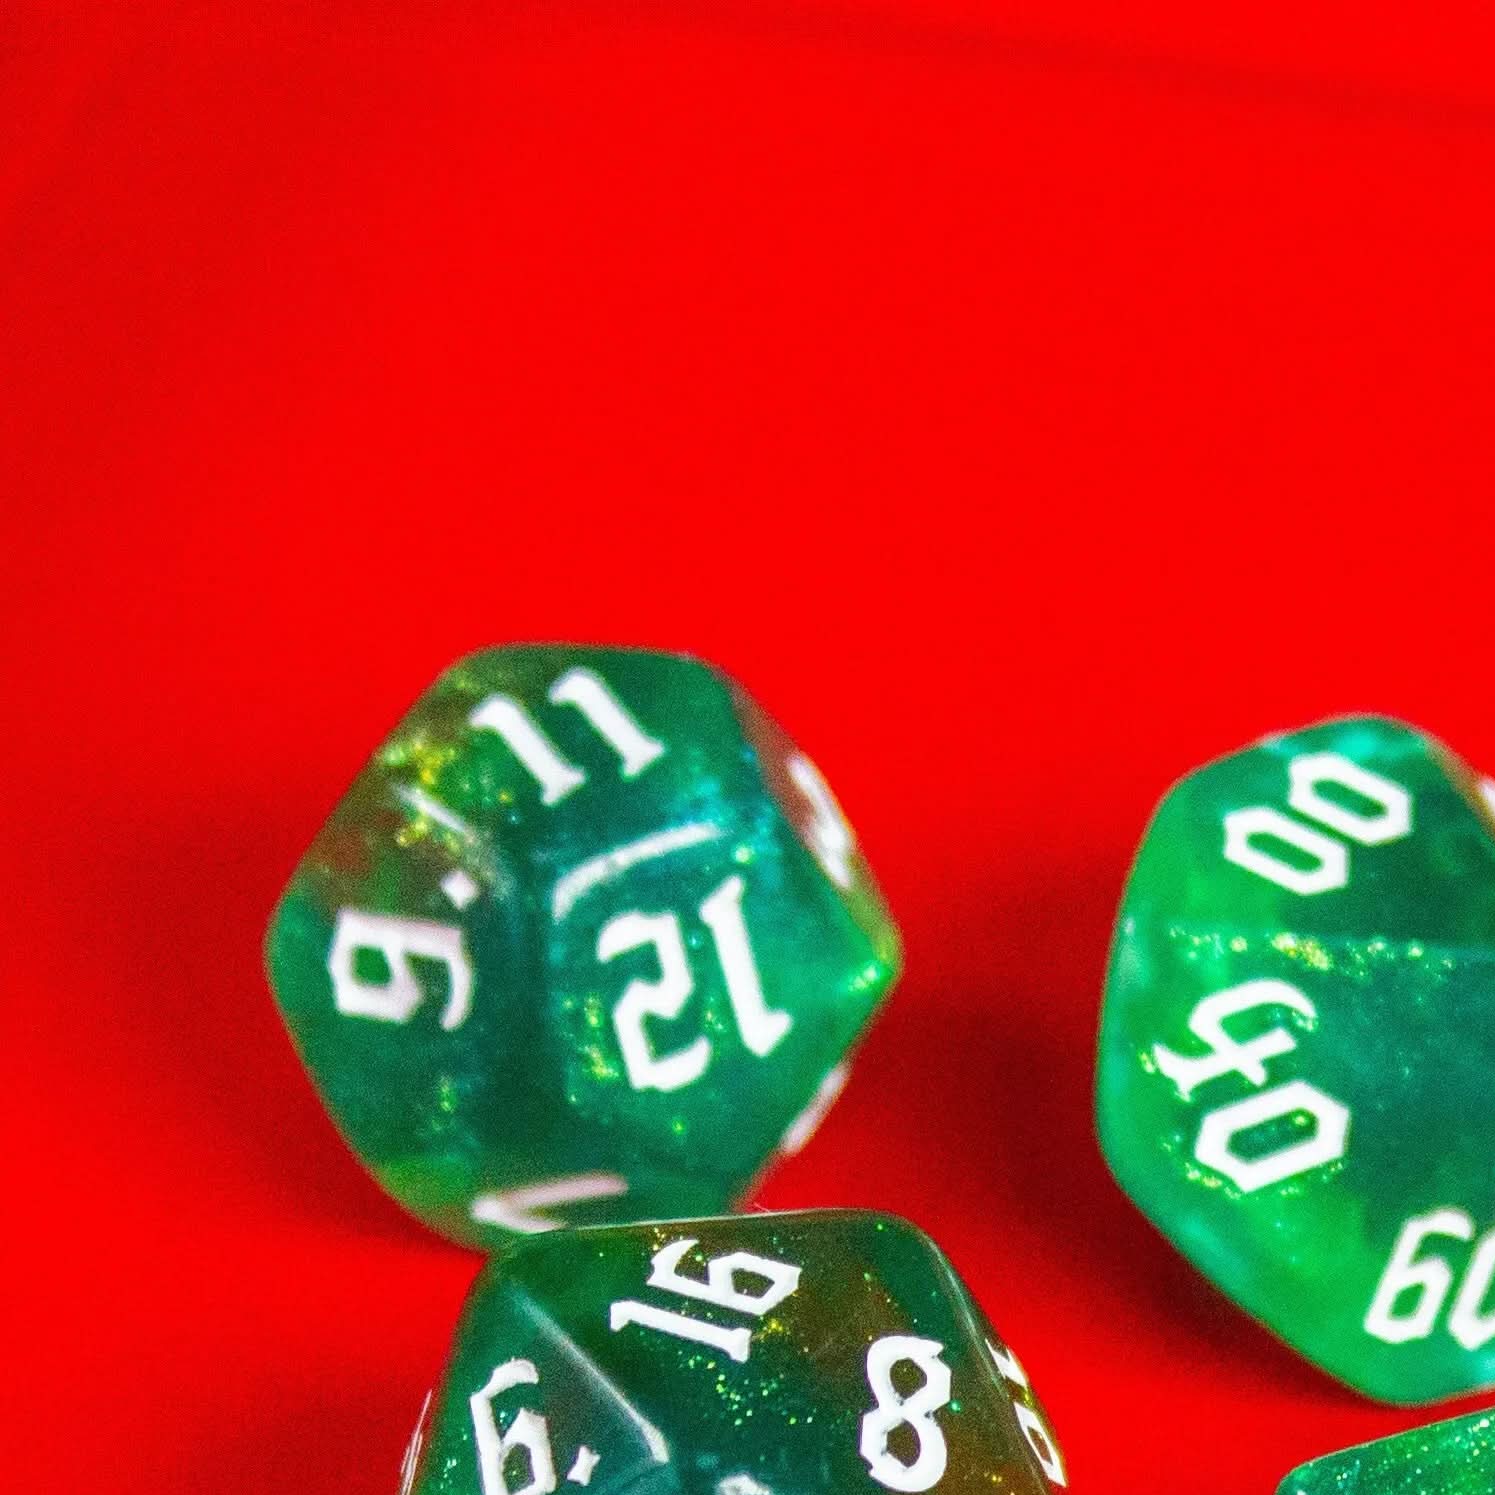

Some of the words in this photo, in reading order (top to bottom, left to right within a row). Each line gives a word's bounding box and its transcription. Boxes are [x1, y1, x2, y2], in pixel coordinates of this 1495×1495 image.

[468, 669, 664, 805] 11
[1222, 751, 1412, 896] 00
[596, 875, 792, 1092] 12
[1152, 978, 1350, 1194] 40
[609, 1234, 804, 1364] 16
[858, 1334, 953, 1494] 8
